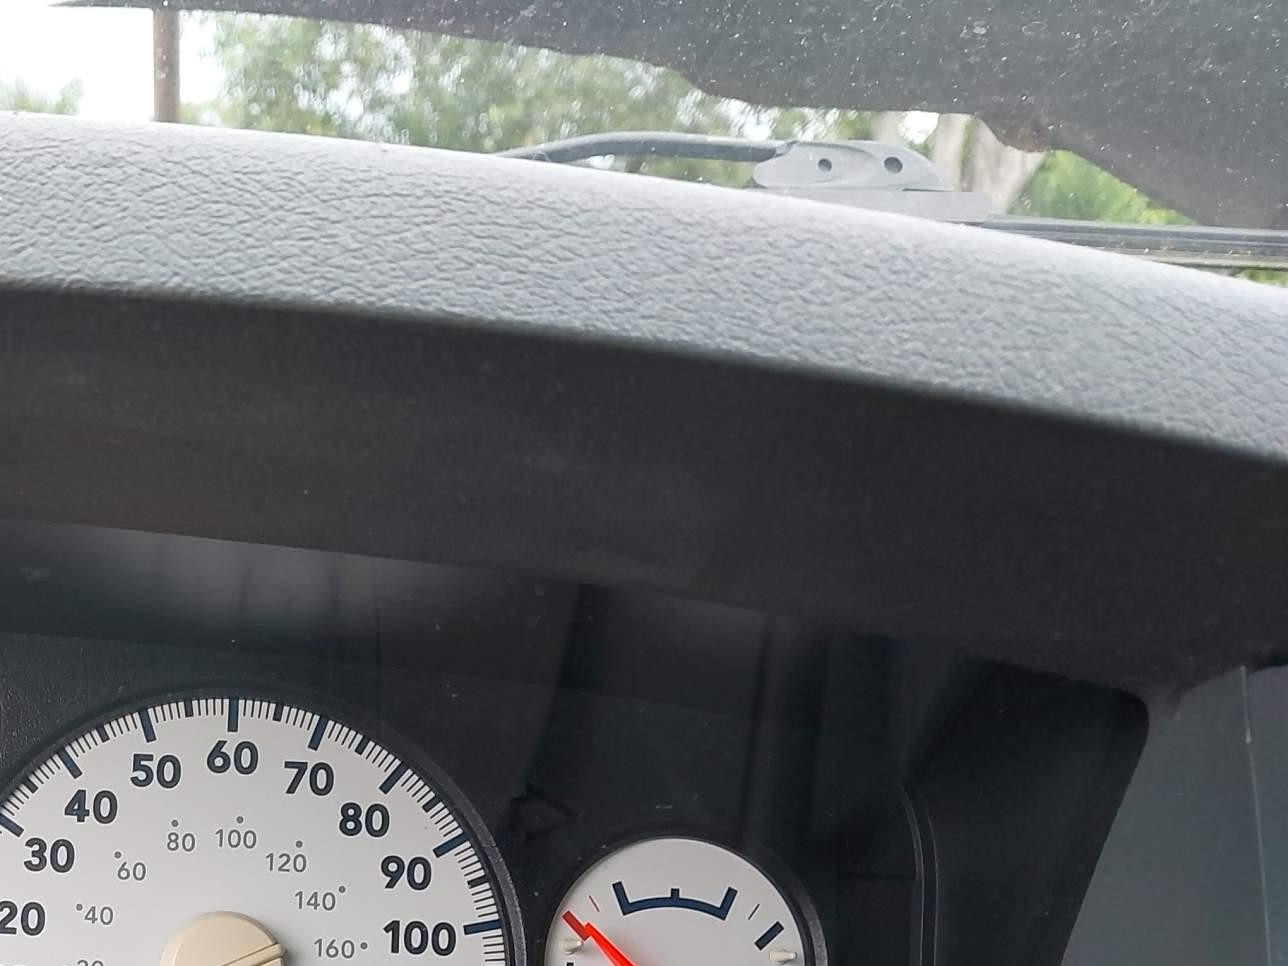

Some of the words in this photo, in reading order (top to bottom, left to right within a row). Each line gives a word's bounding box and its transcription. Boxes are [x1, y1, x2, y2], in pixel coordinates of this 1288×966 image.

[130, 754, 181, 788] 50
[207, 740, 258, 775] 60
[285, 761, 334, 796] 70
[65, 789, 117, 824] 40
[339, 803, 389, 837] 80
[24, 838, 75, 873] 30
[167, 832, 195, 852] 80
[216, 829, 256, 849] 100
[118, 862, 146, 881] 60
[266, 853, 306, 872] 120
[380, 856, 431, 890] 90
[84, 906, 113, 925] 40
[294, 891, 336, 911] 140
[314, 939, 354, 958] 160
[383, 920, 456, 956] 100
